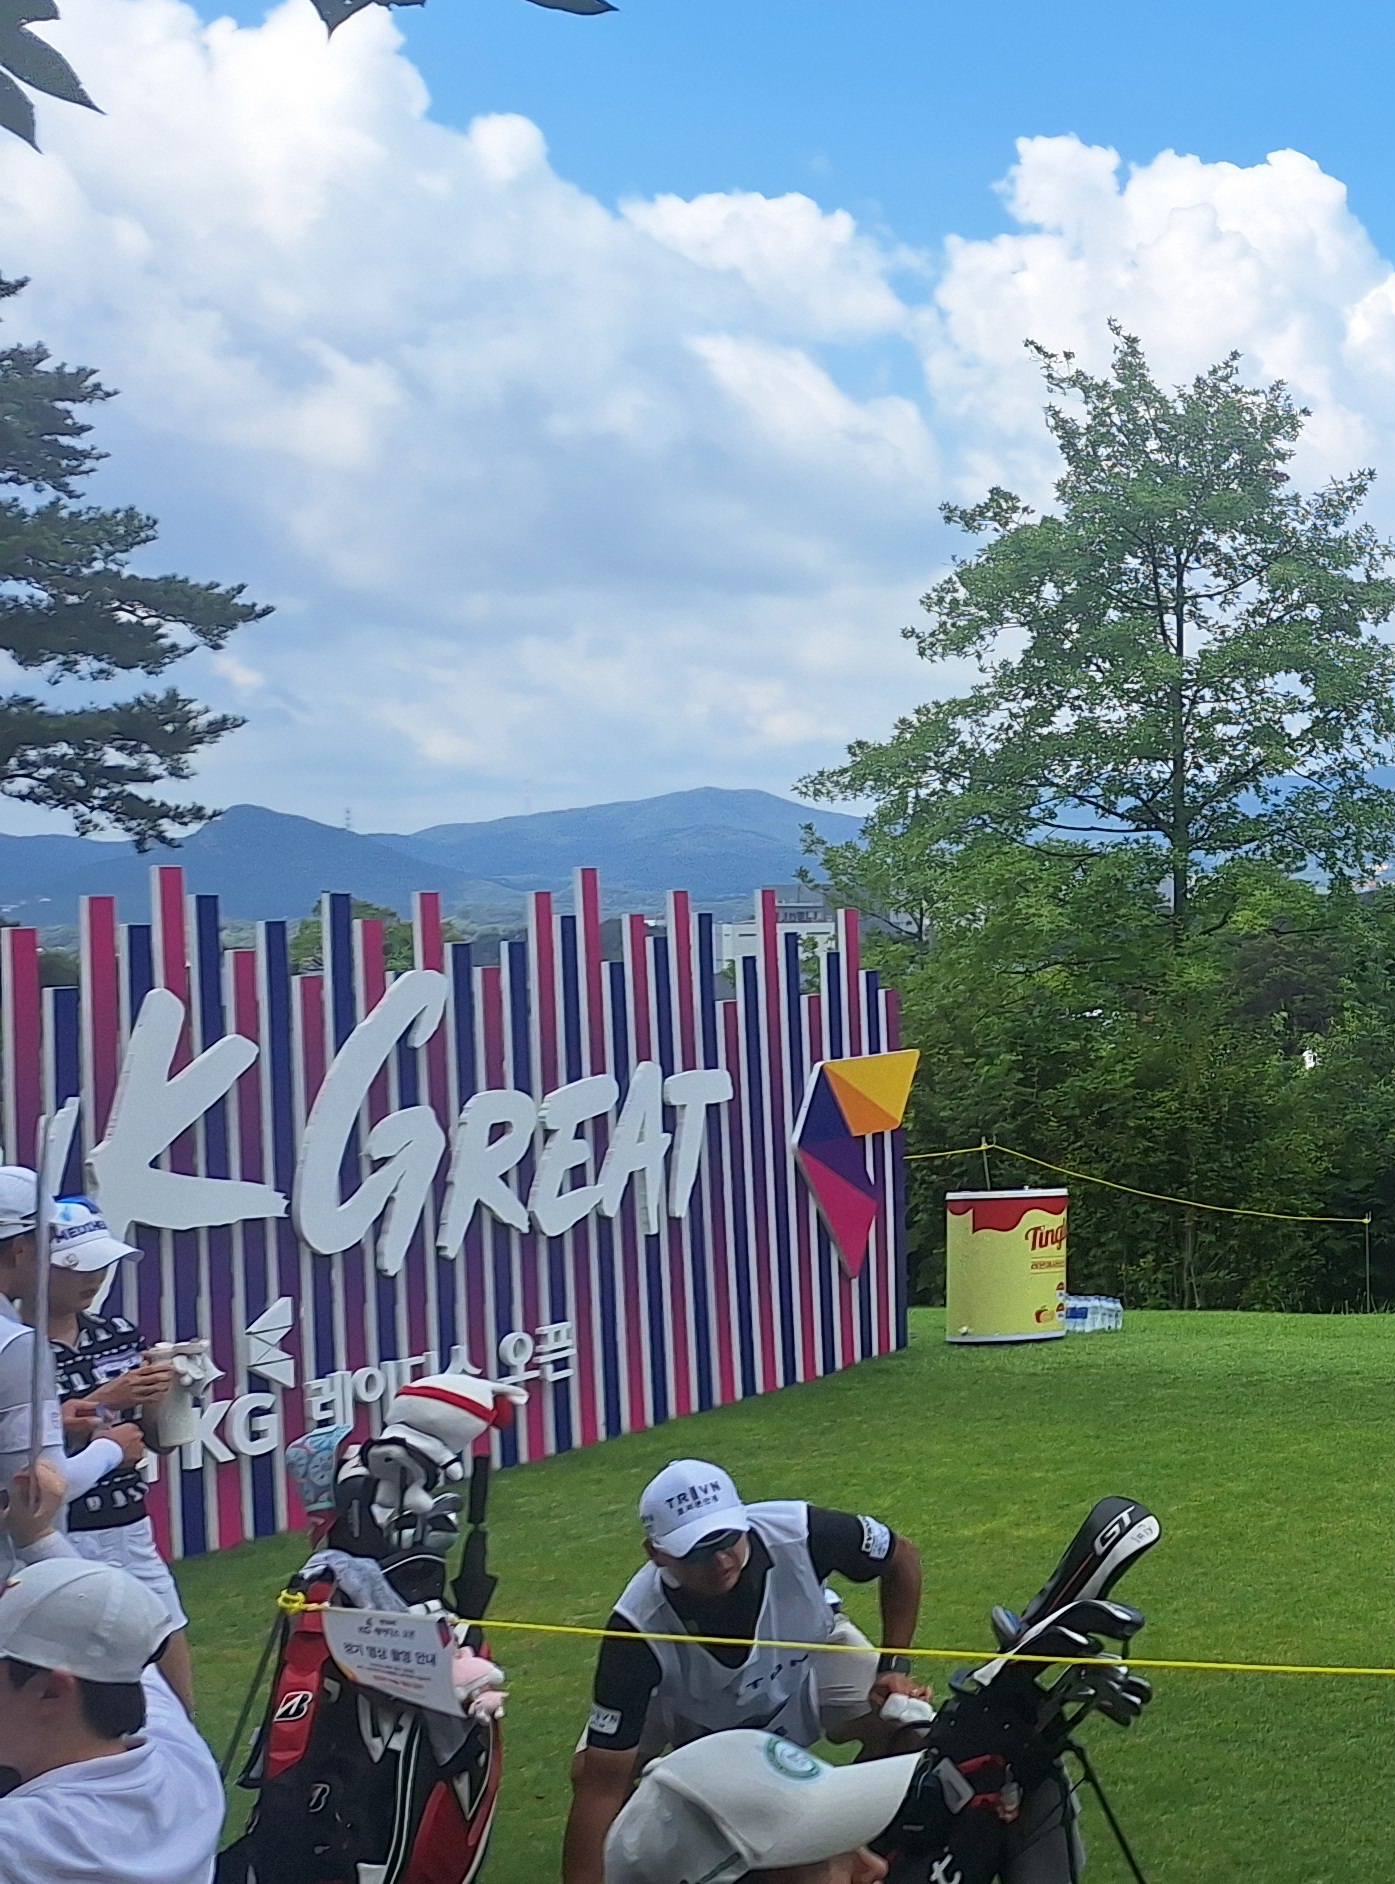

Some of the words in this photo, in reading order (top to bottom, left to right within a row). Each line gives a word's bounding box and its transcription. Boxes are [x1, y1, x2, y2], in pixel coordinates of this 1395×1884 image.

[294, 969, 735, 1276] GREAT
[182, 1392, 279, 1471] KG
[497, 1321, 578, 1385] 오픈
[1094, 1504, 1136, 1556] GT
